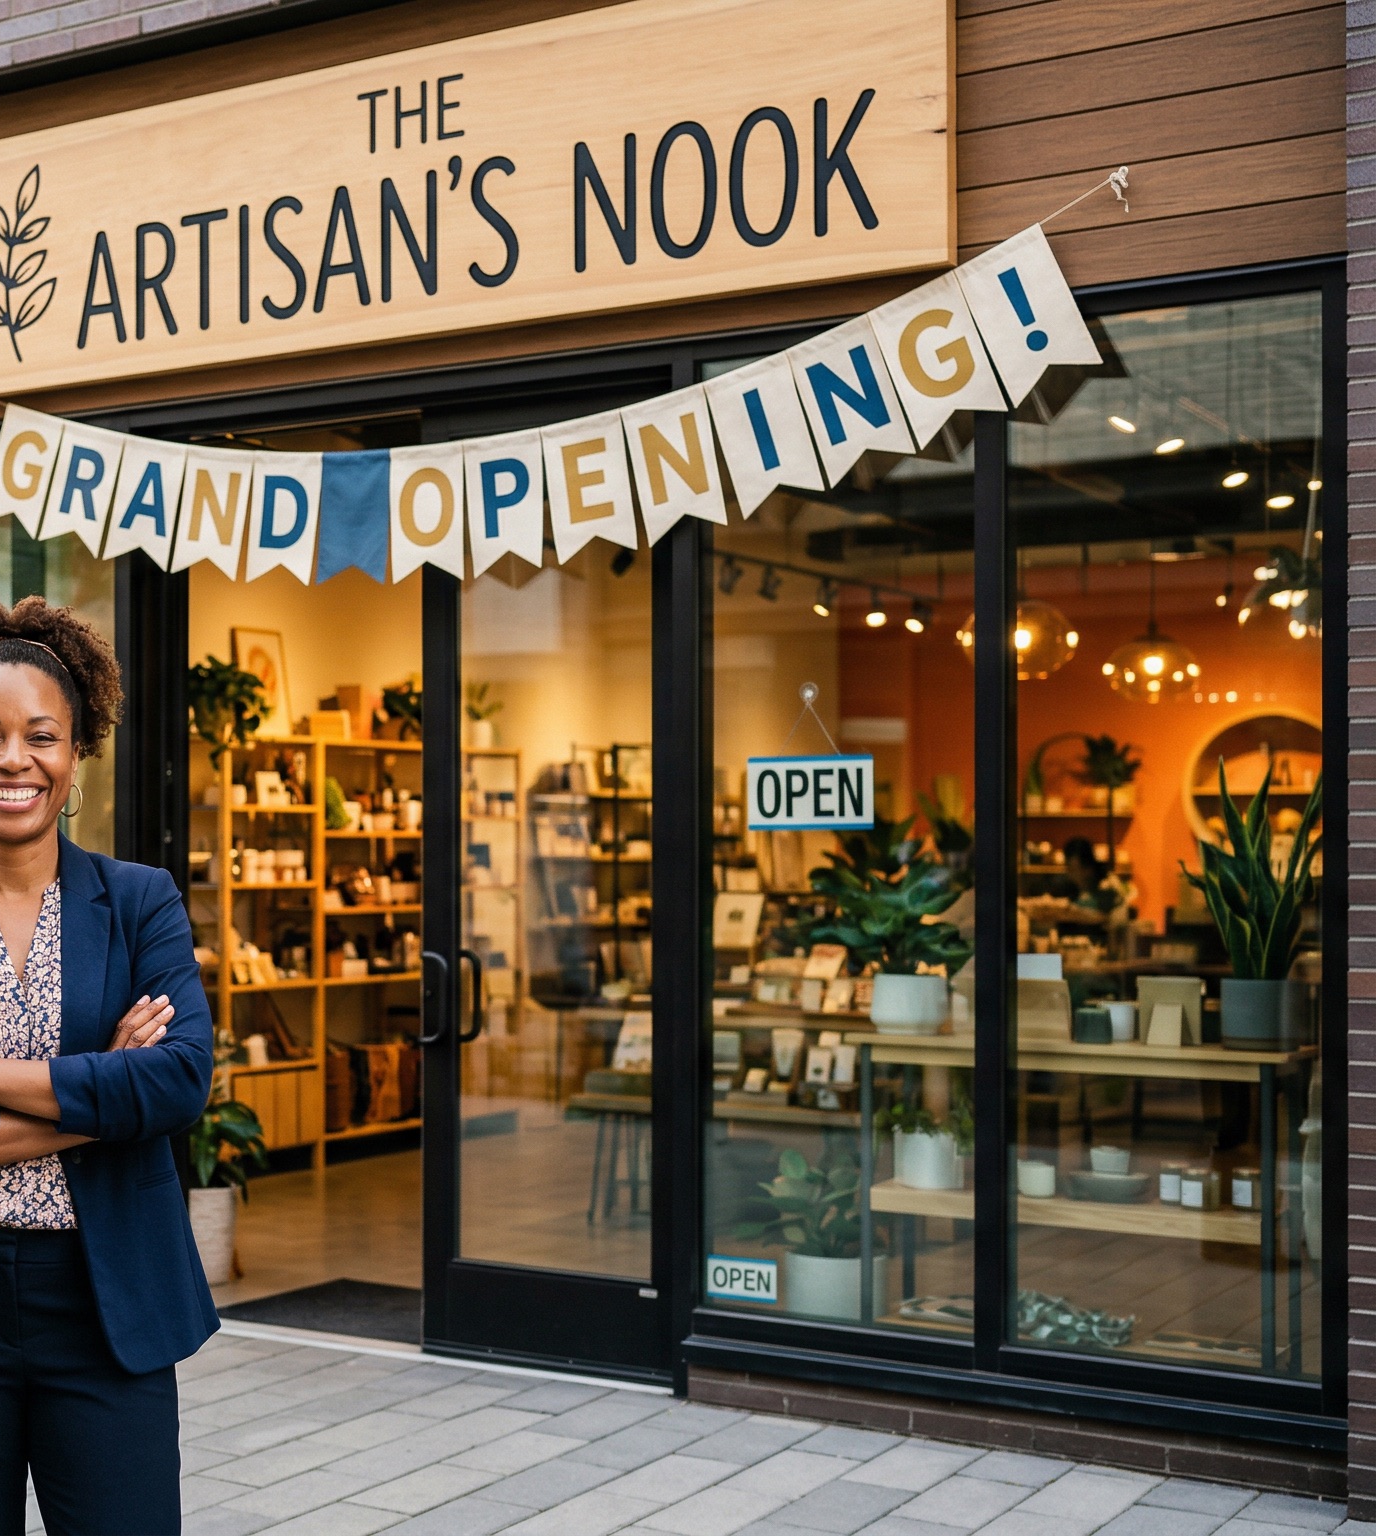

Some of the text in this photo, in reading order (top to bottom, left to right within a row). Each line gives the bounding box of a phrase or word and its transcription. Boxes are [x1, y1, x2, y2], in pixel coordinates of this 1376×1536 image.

[356, 73, 466, 154] THE
[76, 88, 880, 350] ARTISAN'S NOOK
[1, 266, 1050, 552] GRAND OPENING!
[757, 767, 864, 818] OPEN
[713, 1266, 771, 1292] OPEN
